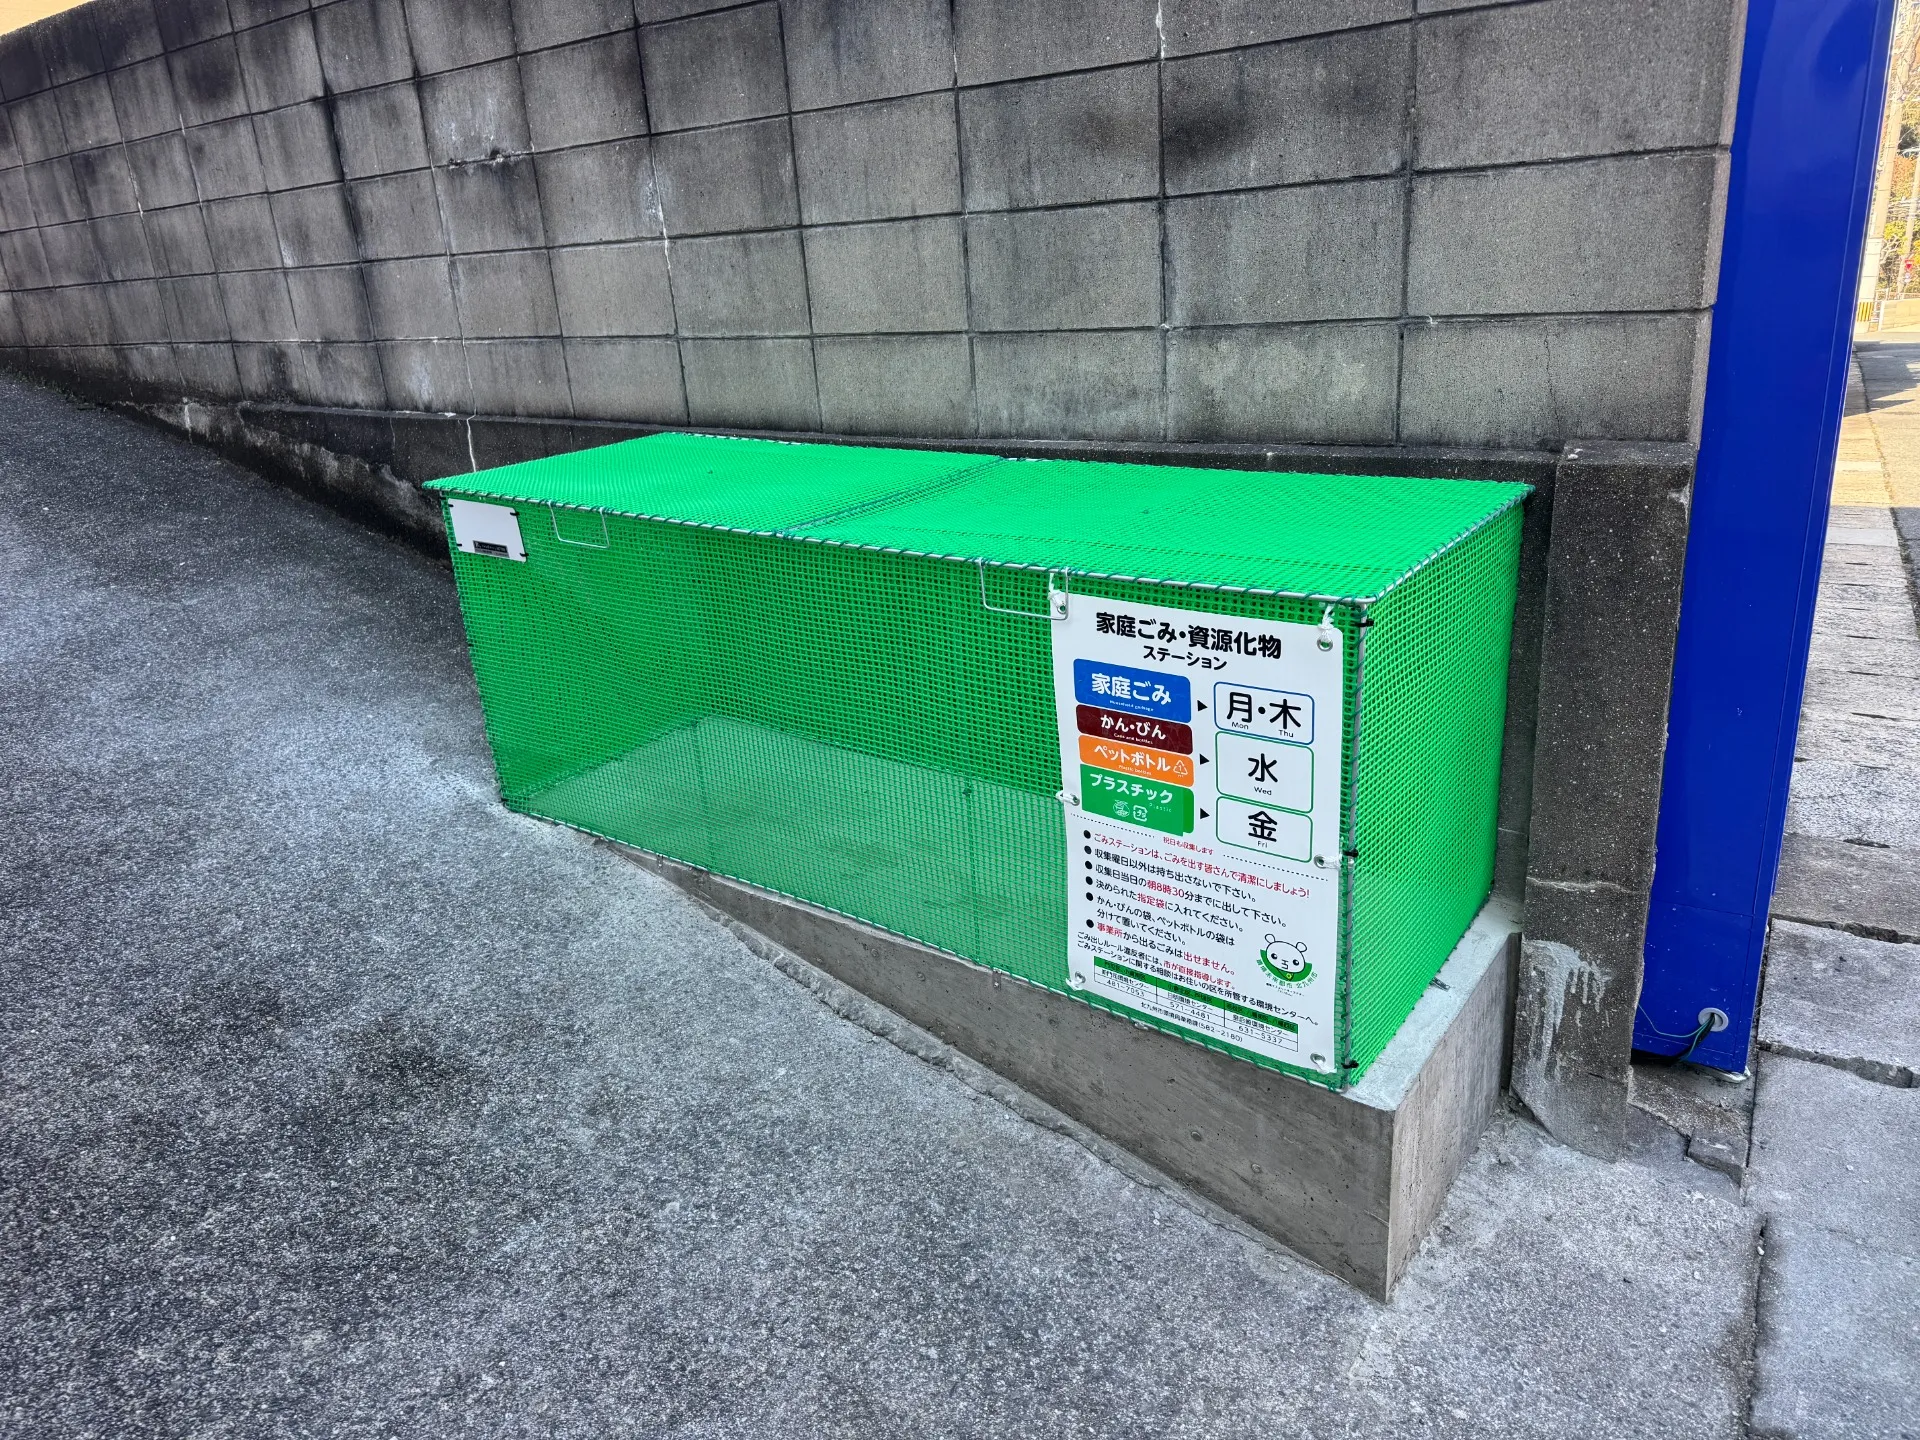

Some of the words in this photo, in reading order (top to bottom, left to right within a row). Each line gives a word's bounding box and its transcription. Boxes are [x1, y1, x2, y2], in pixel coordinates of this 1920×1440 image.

[1096, 612, 1282, 659] 家庭ごみ・資源化物
[1143, 645, 1228, 671] ステーション
[1092, 673, 1171, 705] 家庭ごみ
[1100, 714, 1167, 740] かん・びん
[1226, 692, 1302, 730] 月・木
[1231, 721, 1249, 730] Mon
[1278, 729, 1294, 738] Thu
[1094, 743, 1172, 772] ペットボトル
[1247, 753, 1279, 783] 水
[1090, 773, 1173, 804] プラスチック
[1254, 786, 1273, 796] Wed
[1247, 810, 1278, 843] 金
[1163, 836, 1214, 855] 祝日も収集します
[1257, 840, 1268, 848] Fri
[1094, 848, 1256, 902] 収集曜日以外は持ち出さないで下さい。
[1095, 864, 1287, 928] 収集日当日の朝8時30分までに出して下さい。
[1096, 879, 1243, 932] 決められた指定袋に入れてください。
[1096, 895, 1235, 946] かん・びんの袋、ペットボトルの袋は
[1096, 908, 1186, 946] 分けて置いてください。
[1096, 921, 1235, 976] 事業所から出るごみは出せません。
